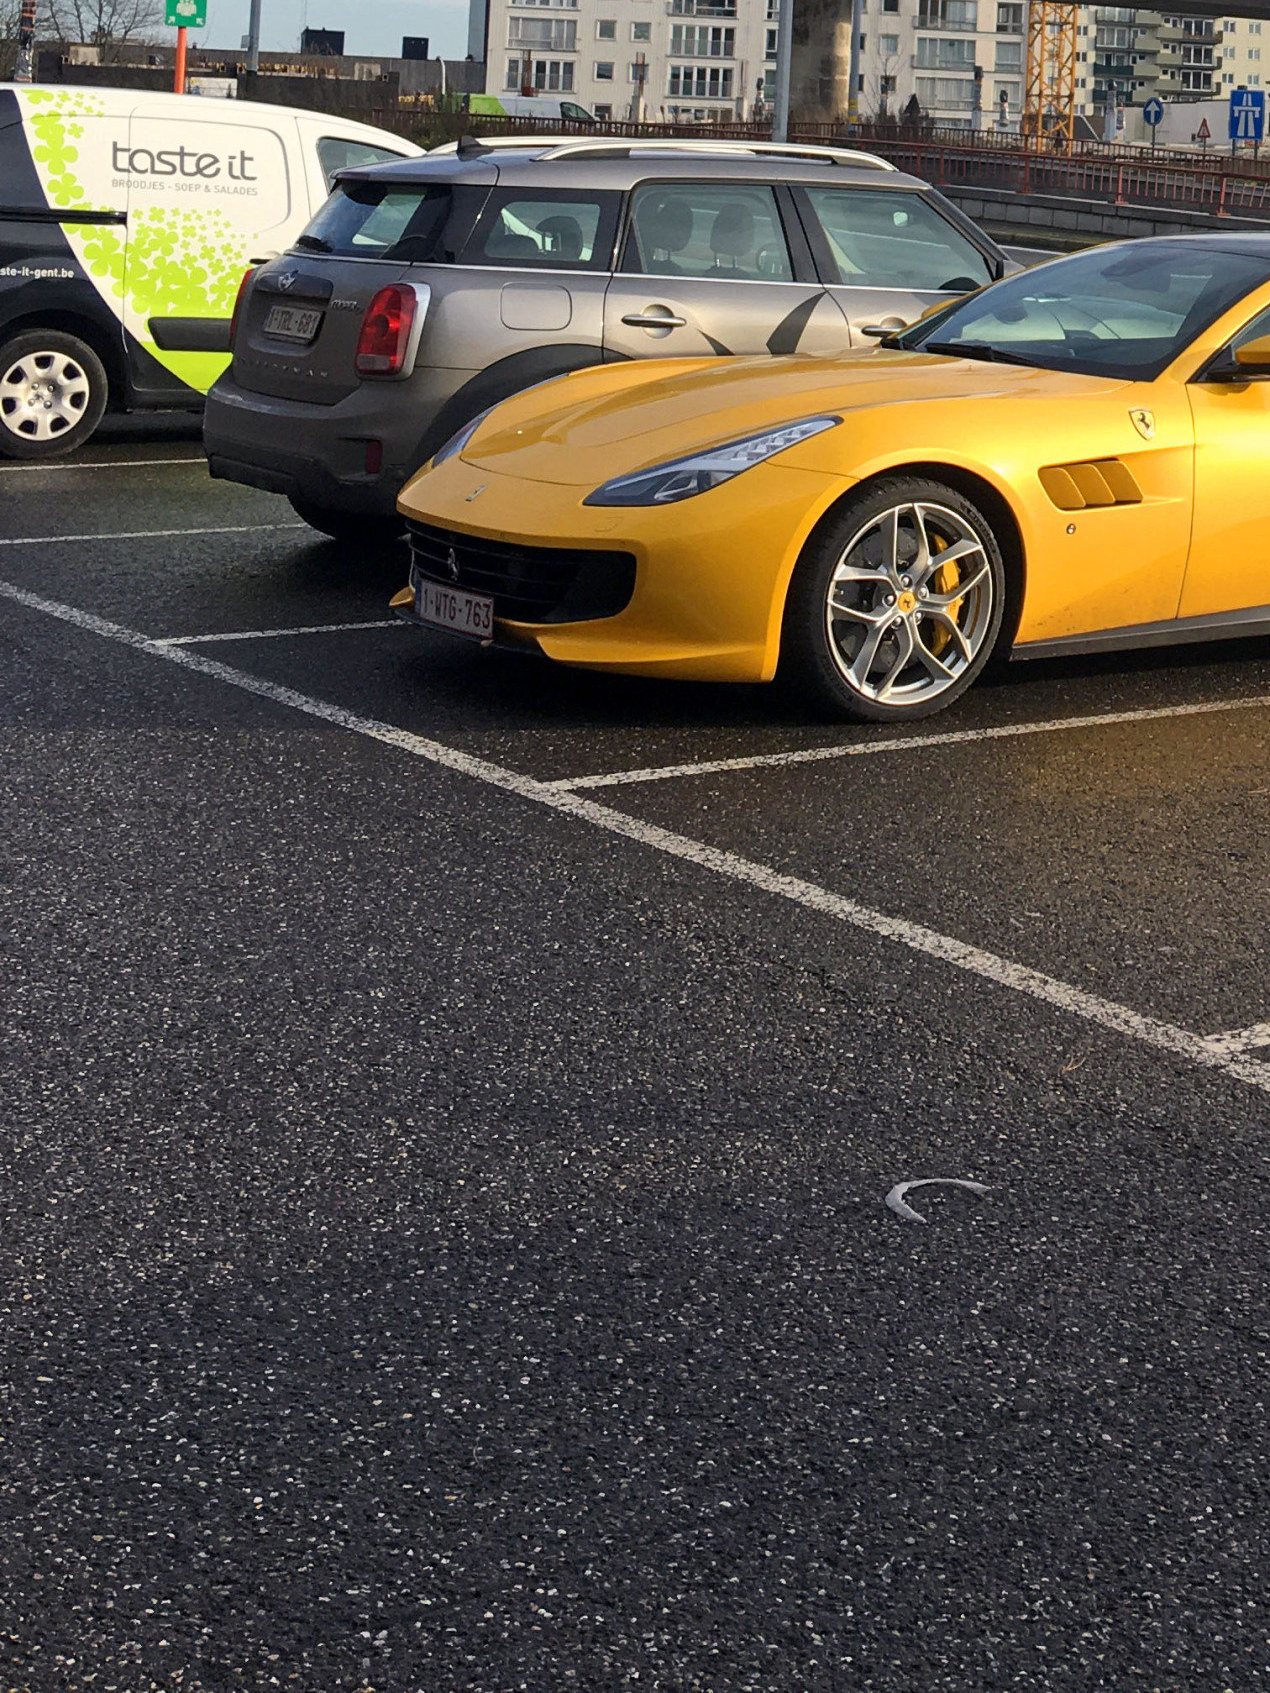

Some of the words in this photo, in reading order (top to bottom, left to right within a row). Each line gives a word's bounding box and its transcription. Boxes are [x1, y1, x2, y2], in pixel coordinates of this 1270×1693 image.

[112, 141, 221, 178] taste
[228, 150, 258, 181] it
[112, 178, 165, 190] BROODJES
[175, 182, 201, 192] SOEP
[203, 184, 211, 193] &
[214, 184, 258, 196] SALADES
[424, 588, 491, 629] 1-WTG-763
